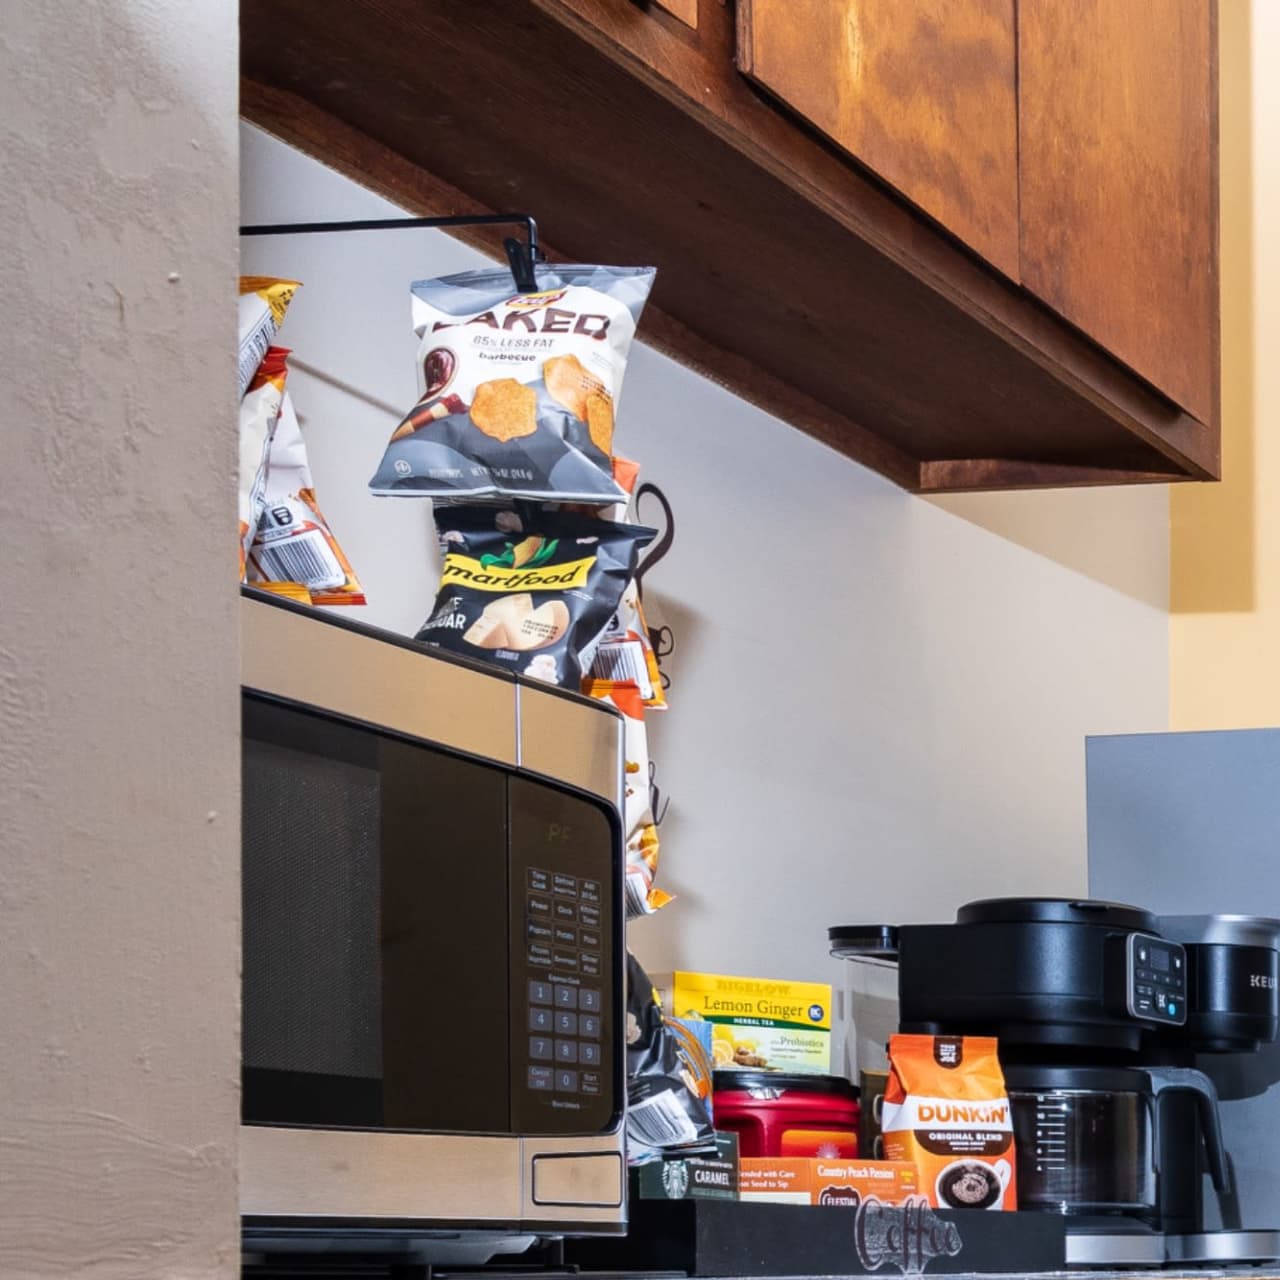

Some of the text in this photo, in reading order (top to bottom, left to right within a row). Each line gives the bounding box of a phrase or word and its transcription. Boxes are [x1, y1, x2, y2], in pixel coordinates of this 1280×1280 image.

[704, 996, 804, 1018] Lemon Ginger
[733, 1017, 775, 1026] HERBAL TEA
[928, 1132, 1003, 1142] ORIGINAL BLEND
[695, 1169, 730, 1186] CARAMEL
[817, 1164, 848, 1180] Country
[848, 1166, 870, 1178] Peach
[857, 1197, 961, 1273] Coffee
